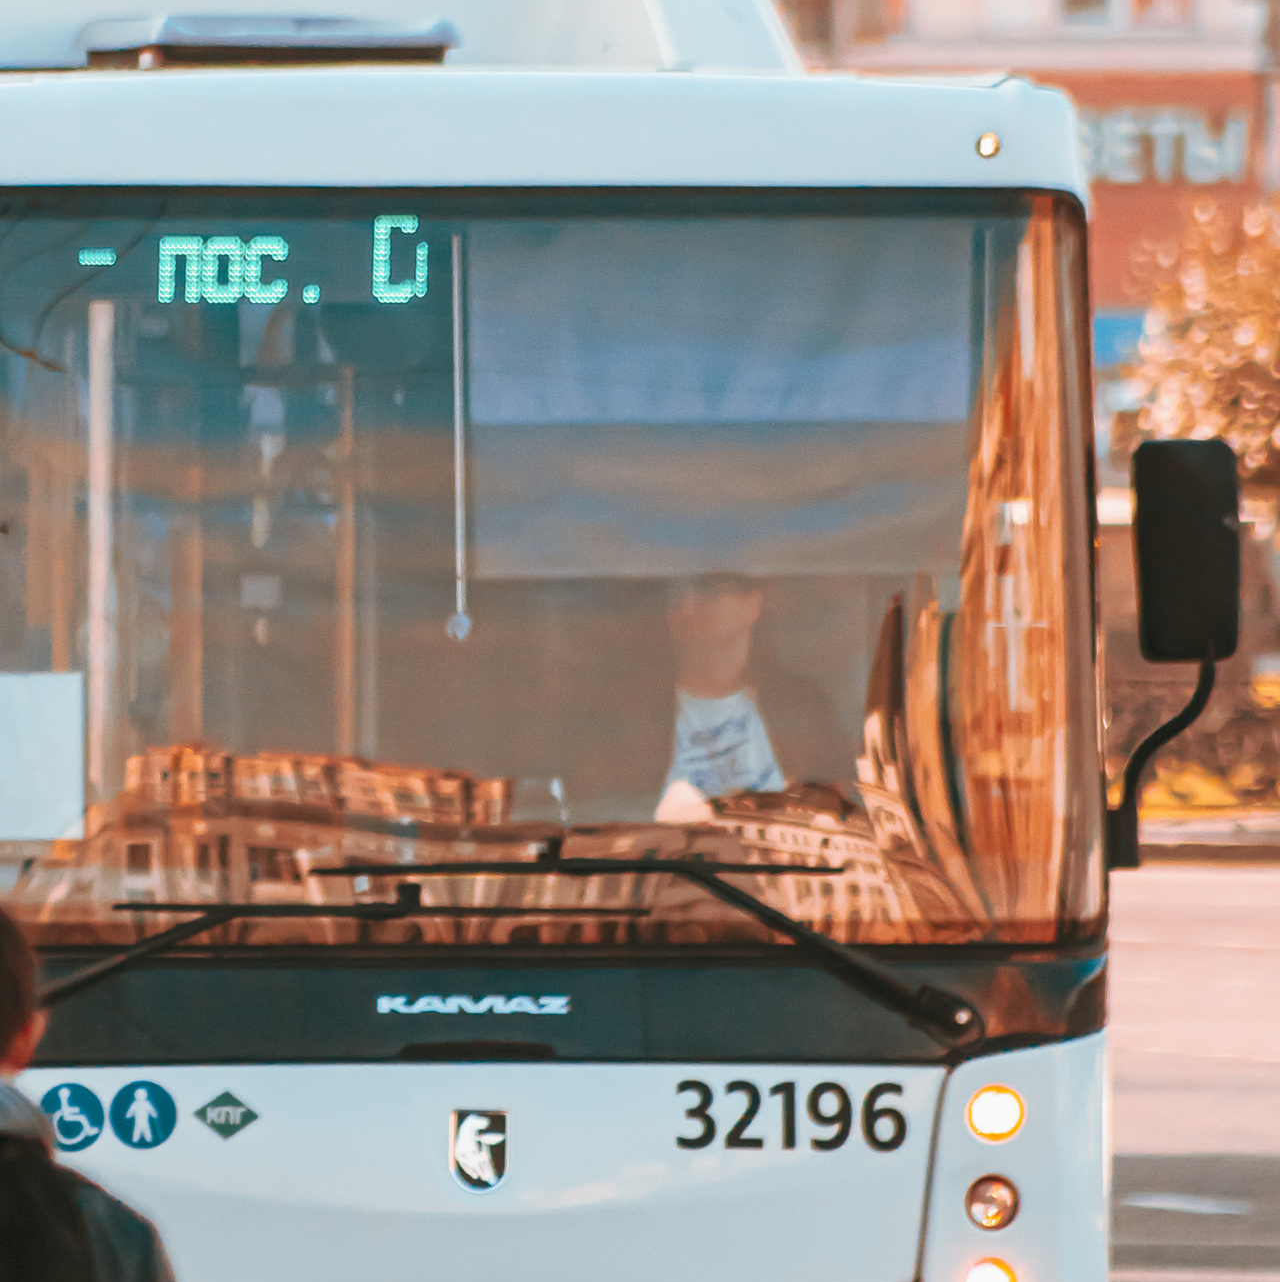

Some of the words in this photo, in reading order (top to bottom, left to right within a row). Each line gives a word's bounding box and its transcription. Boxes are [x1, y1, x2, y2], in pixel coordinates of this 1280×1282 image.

[158, 235, 320, 303] пос.
[372, 214, 428, 303] С
[376, 995, 570, 1015] KAMAZ
[675, 1079, 908, 1154] 32196
